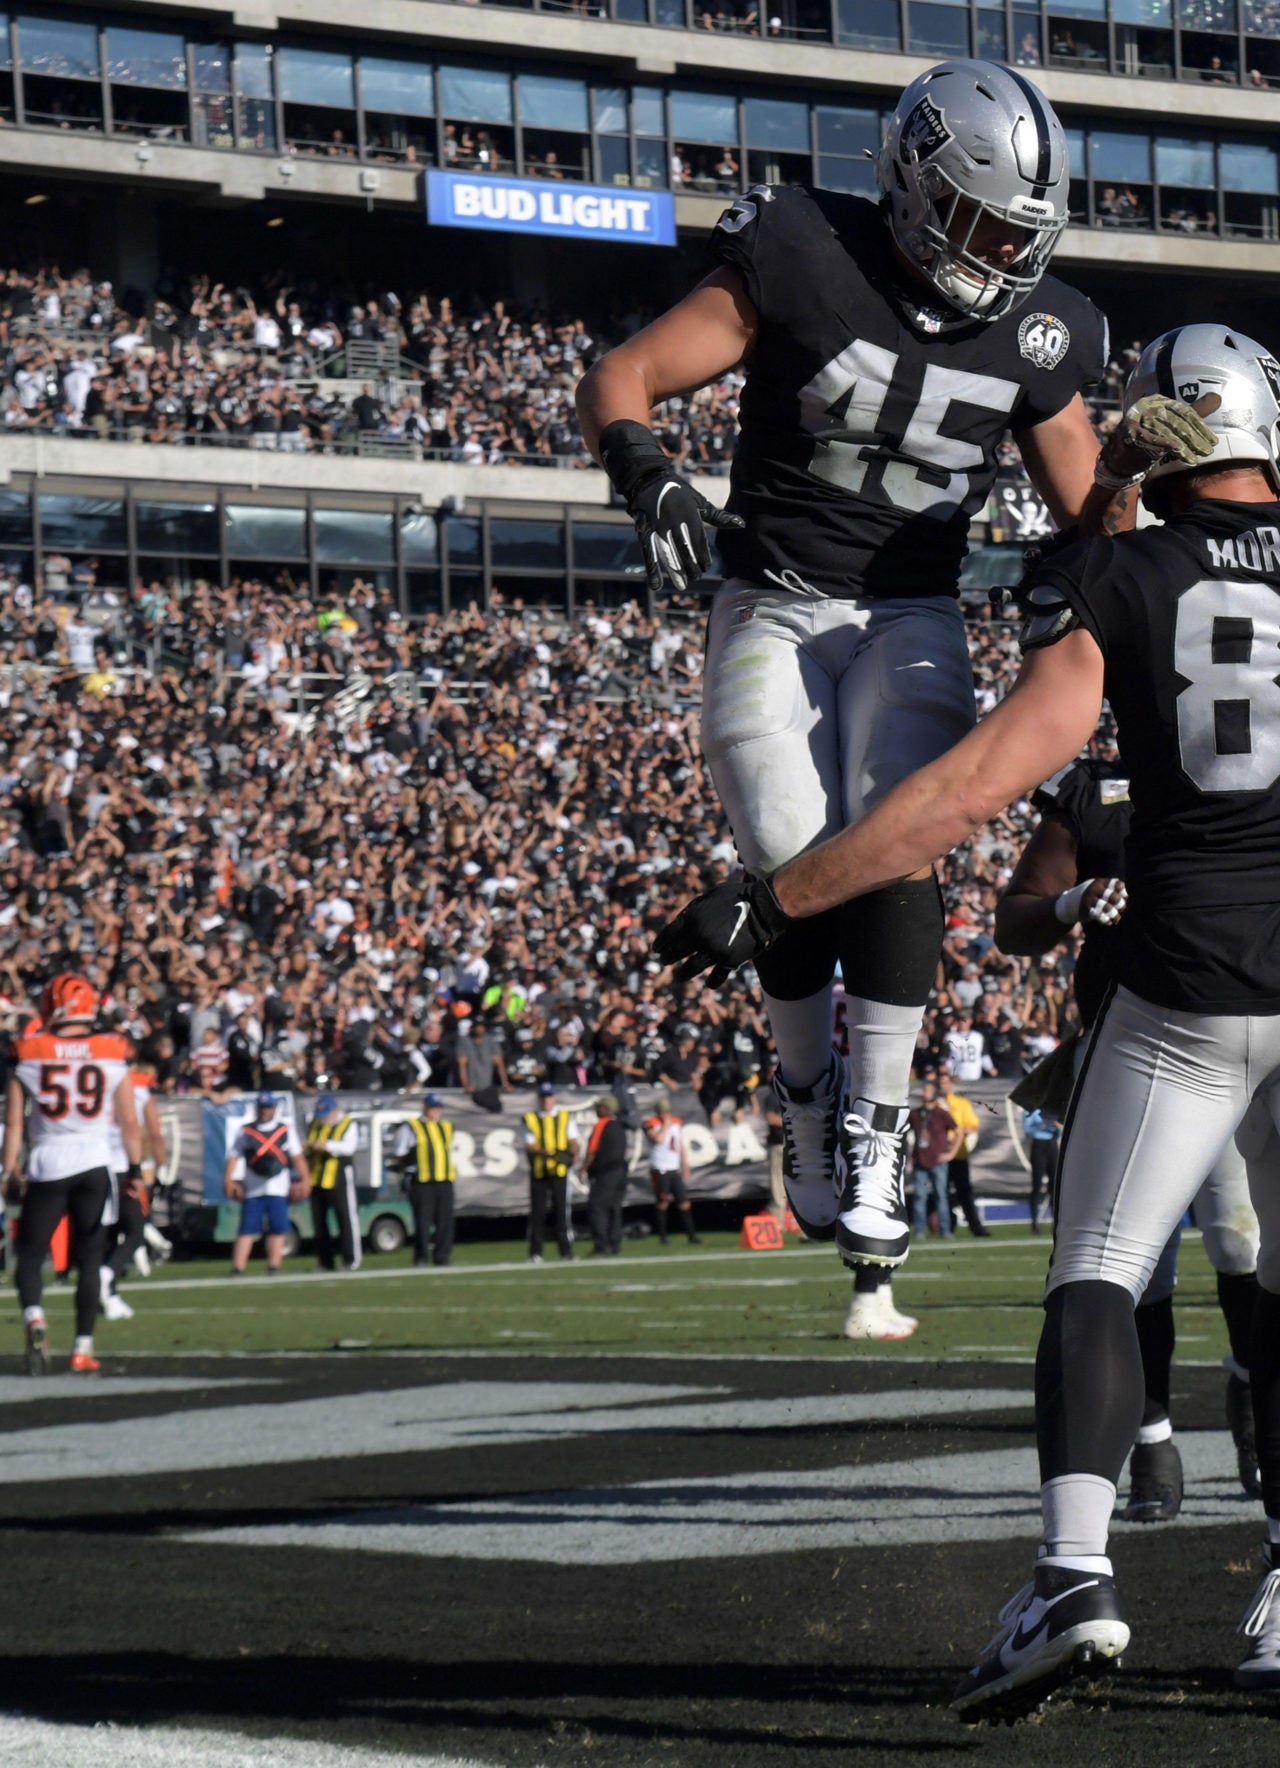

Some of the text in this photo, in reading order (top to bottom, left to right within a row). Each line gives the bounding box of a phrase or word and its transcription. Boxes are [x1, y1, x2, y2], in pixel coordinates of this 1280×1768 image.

[921, 101, 947, 138] RAIDERS
[453, 184, 650, 232] BUD LIGHT
[1021, 204, 1048, 216] RAIDERS
[1026, 324, 1063, 356] 60
[1182, 385, 1198, 397] AL
[797, 338, 1021, 522] 45
[38, 1064, 106, 1121] 59
[752, 1221, 779, 1245] 20
